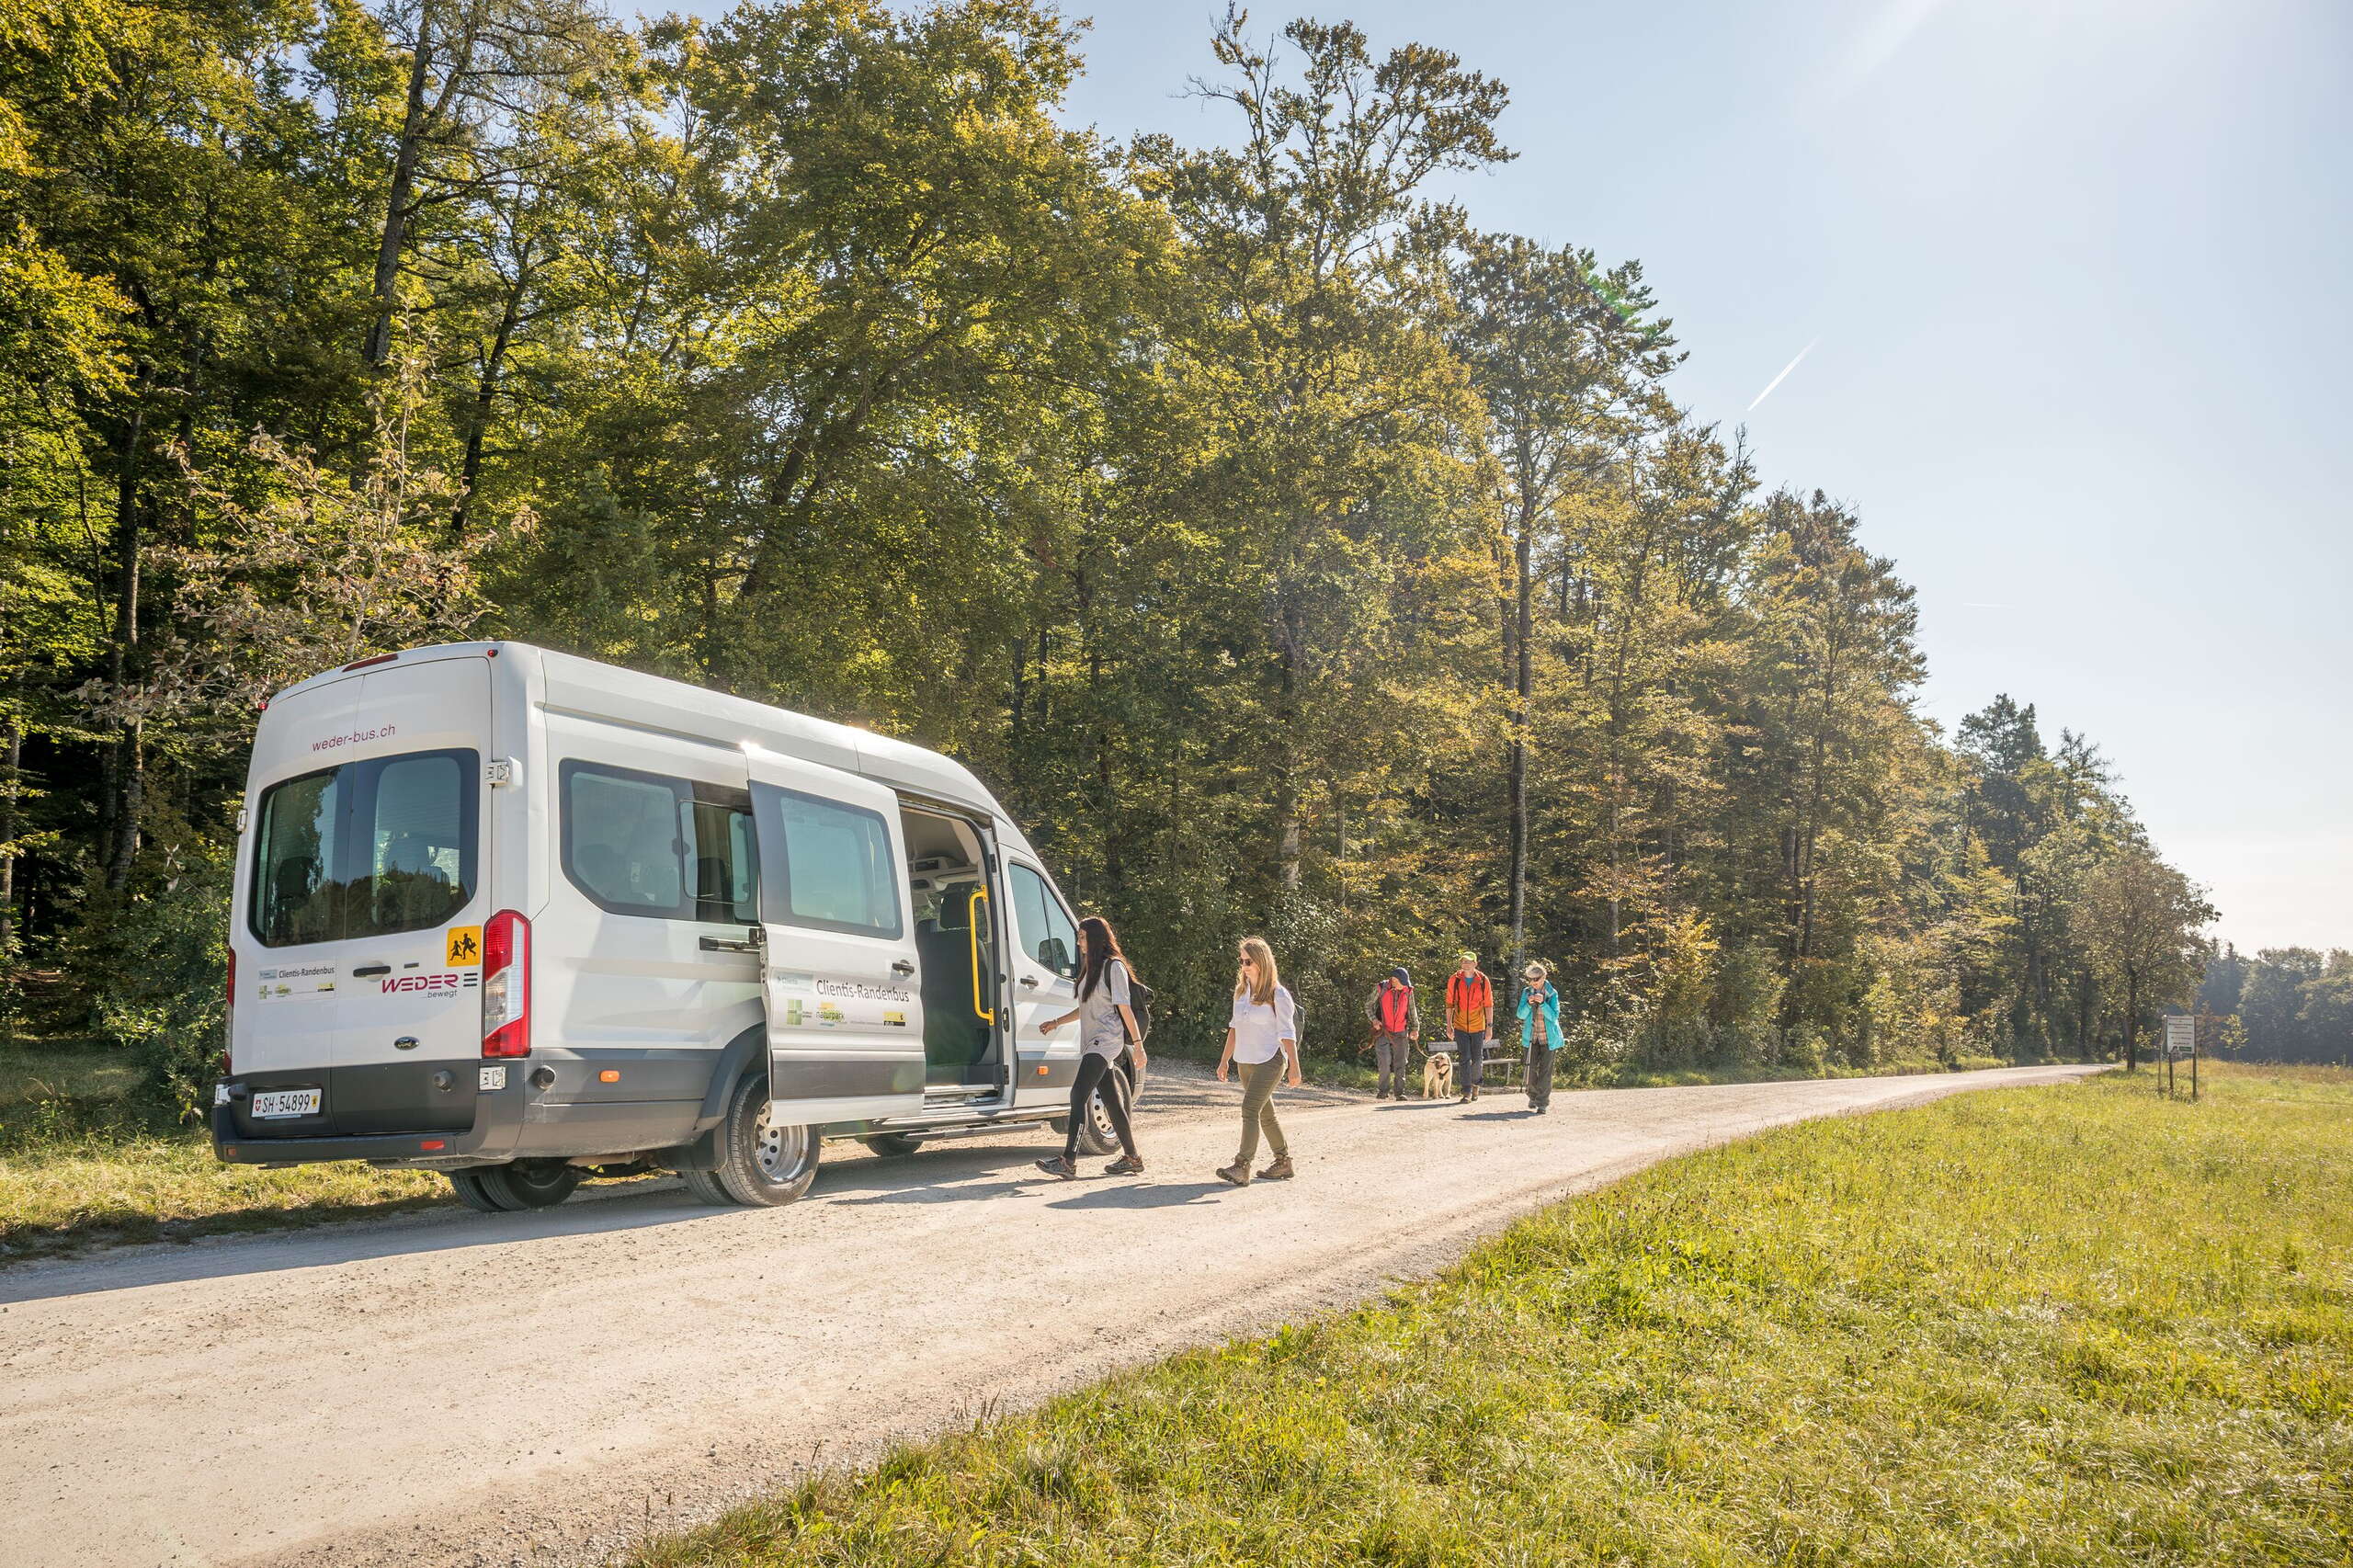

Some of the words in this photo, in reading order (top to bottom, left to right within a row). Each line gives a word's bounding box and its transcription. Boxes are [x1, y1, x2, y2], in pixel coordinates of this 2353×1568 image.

[312, 723, 395, 752] weder-bus.ch
[278, 967, 335, 978] Clientis-Randenbus
[816, 979, 910, 1003] Clientis-Randenbus
